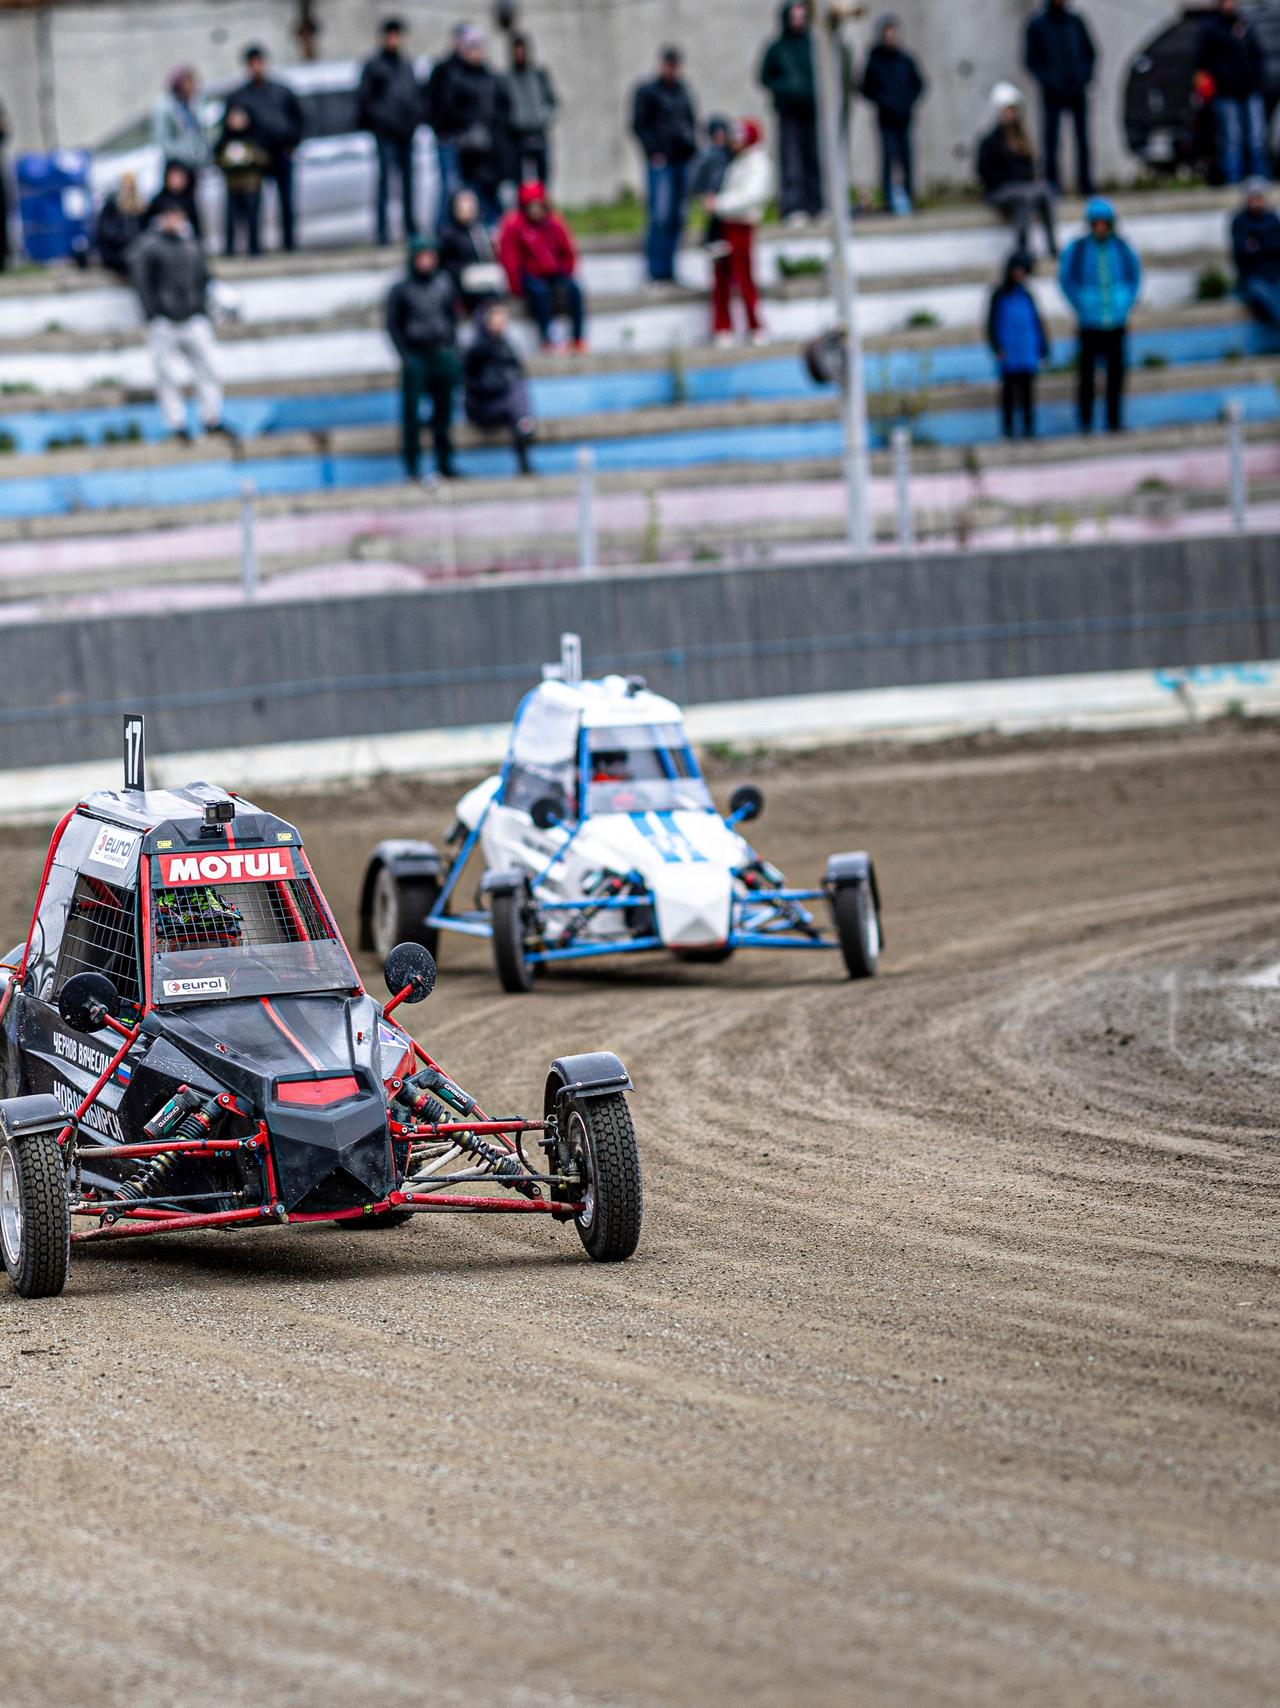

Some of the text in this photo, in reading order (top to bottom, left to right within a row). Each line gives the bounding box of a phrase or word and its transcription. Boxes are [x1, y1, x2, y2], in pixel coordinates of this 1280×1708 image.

[125, 720, 142, 785] 17
[104, 837, 137, 857] eurol
[168, 852, 288, 882] MOTUL
[181, 978, 222, 990] eurol
[53, 1031, 78, 1062] ЧЕРНОВ
